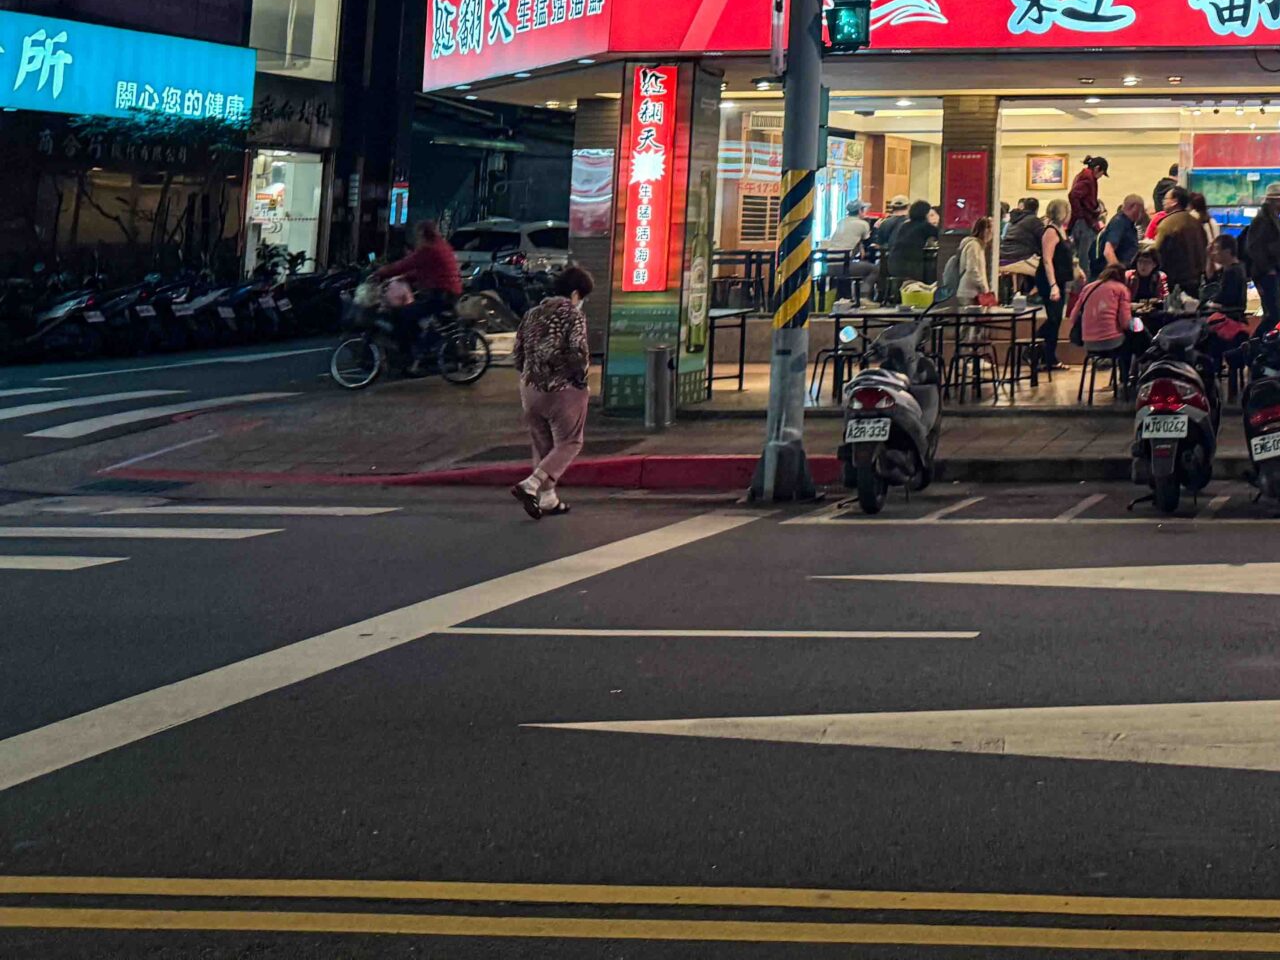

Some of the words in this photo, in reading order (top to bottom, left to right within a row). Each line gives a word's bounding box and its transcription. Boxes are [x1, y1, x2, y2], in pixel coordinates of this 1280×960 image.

[115, 81, 245, 120] 關心您的健康
